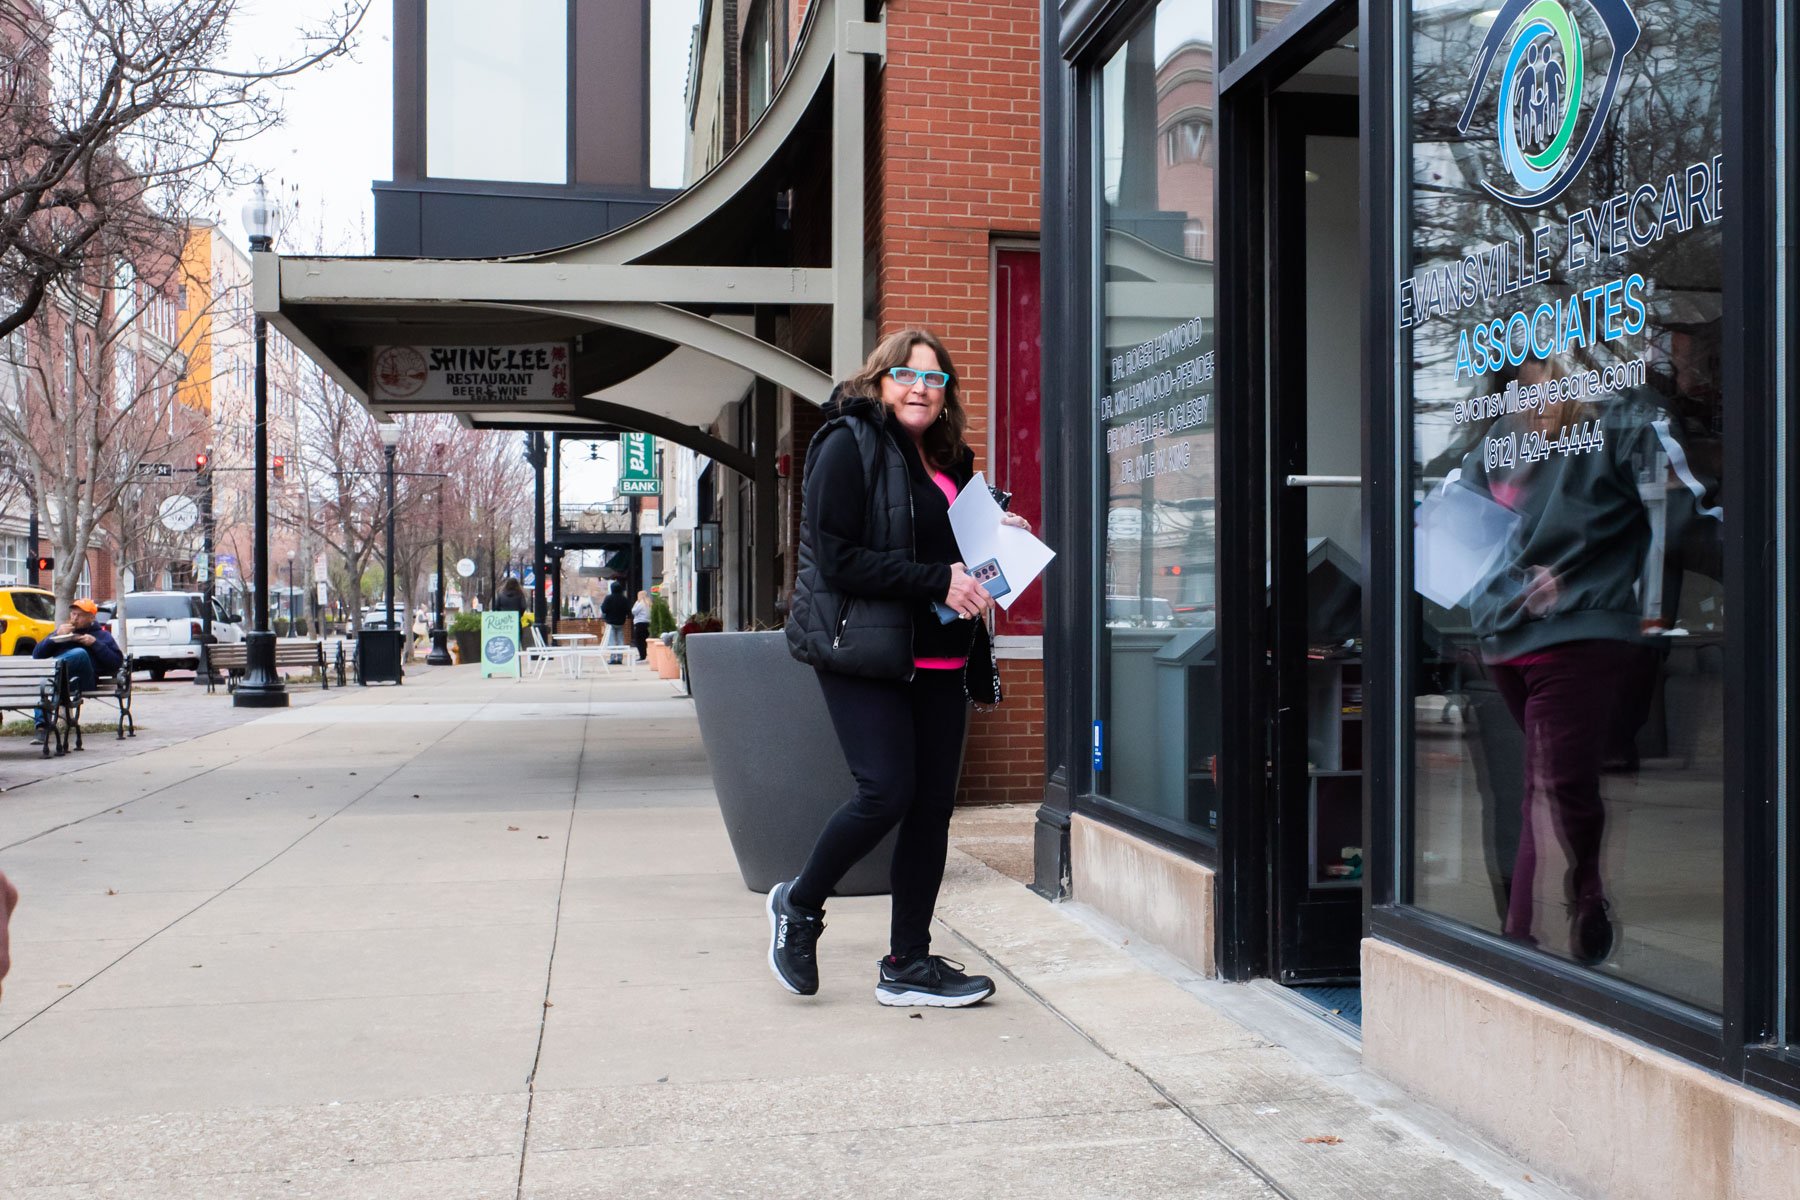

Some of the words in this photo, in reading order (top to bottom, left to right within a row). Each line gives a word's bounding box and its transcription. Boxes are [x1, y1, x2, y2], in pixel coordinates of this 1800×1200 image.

[1399, 225, 1551, 329] EVANSVILLE
[1453, 272, 1647, 381] ASSOCIATES
[1126, 340, 1154, 376] ROGER
[1154, 316, 1202, 363] HAYWOOD
[446, 373, 533, 385] RESTAURANT
[452, 386, 482, 396] BEER
[498, 386, 527, 396] WINE
[1453, 358, 1646, 424] evansvilleeyecare.com
[1168, 394, 1210, 434] OGLESBY
[1168, 441, 1191, 474] KING
[1484, 431, 1516, 473] (812)
[1520, 420, 1604, 462] 424-4444
[623, 481, 656, 491] BANK
[485, 614, 514, 629] River
[777, 914, 789, 950] HOKA
